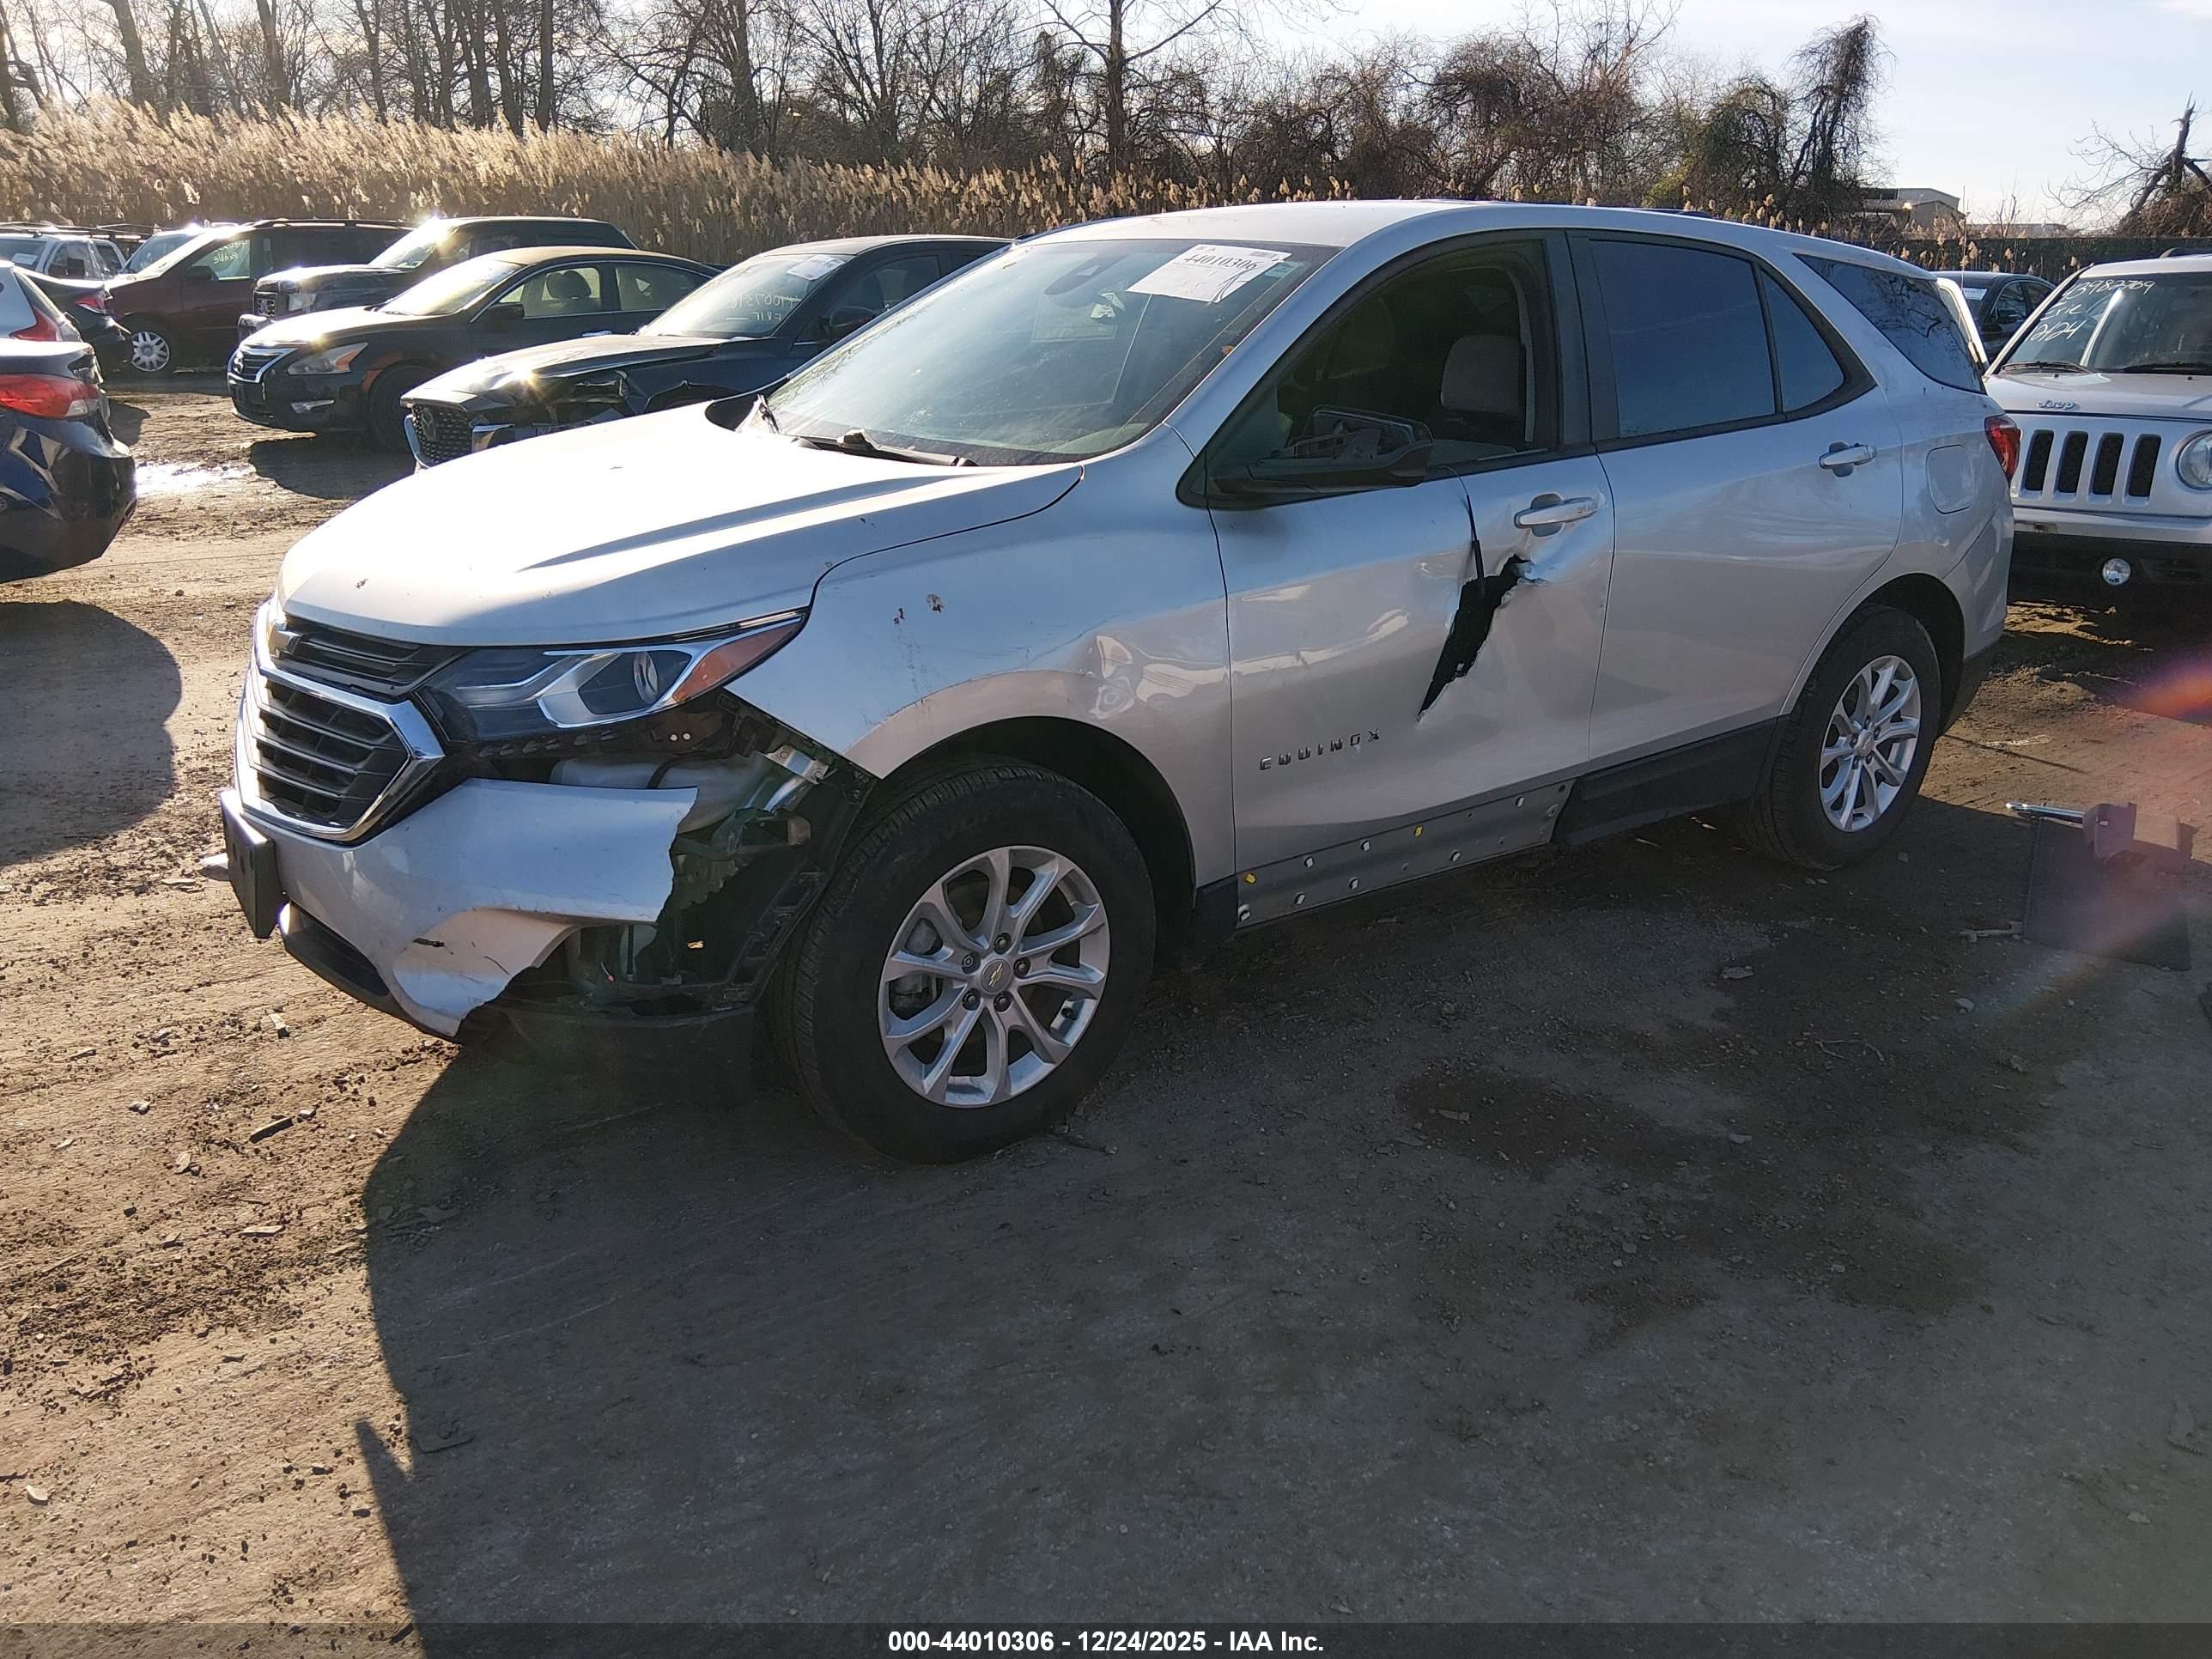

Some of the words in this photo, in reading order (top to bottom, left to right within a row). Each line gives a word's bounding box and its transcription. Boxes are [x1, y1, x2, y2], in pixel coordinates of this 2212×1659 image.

[1182, 253, 1261, 270] 44010306
[2036, 399, 2075, 410] Jeep
[1259, 728, 1380, 770] EQUINOX
